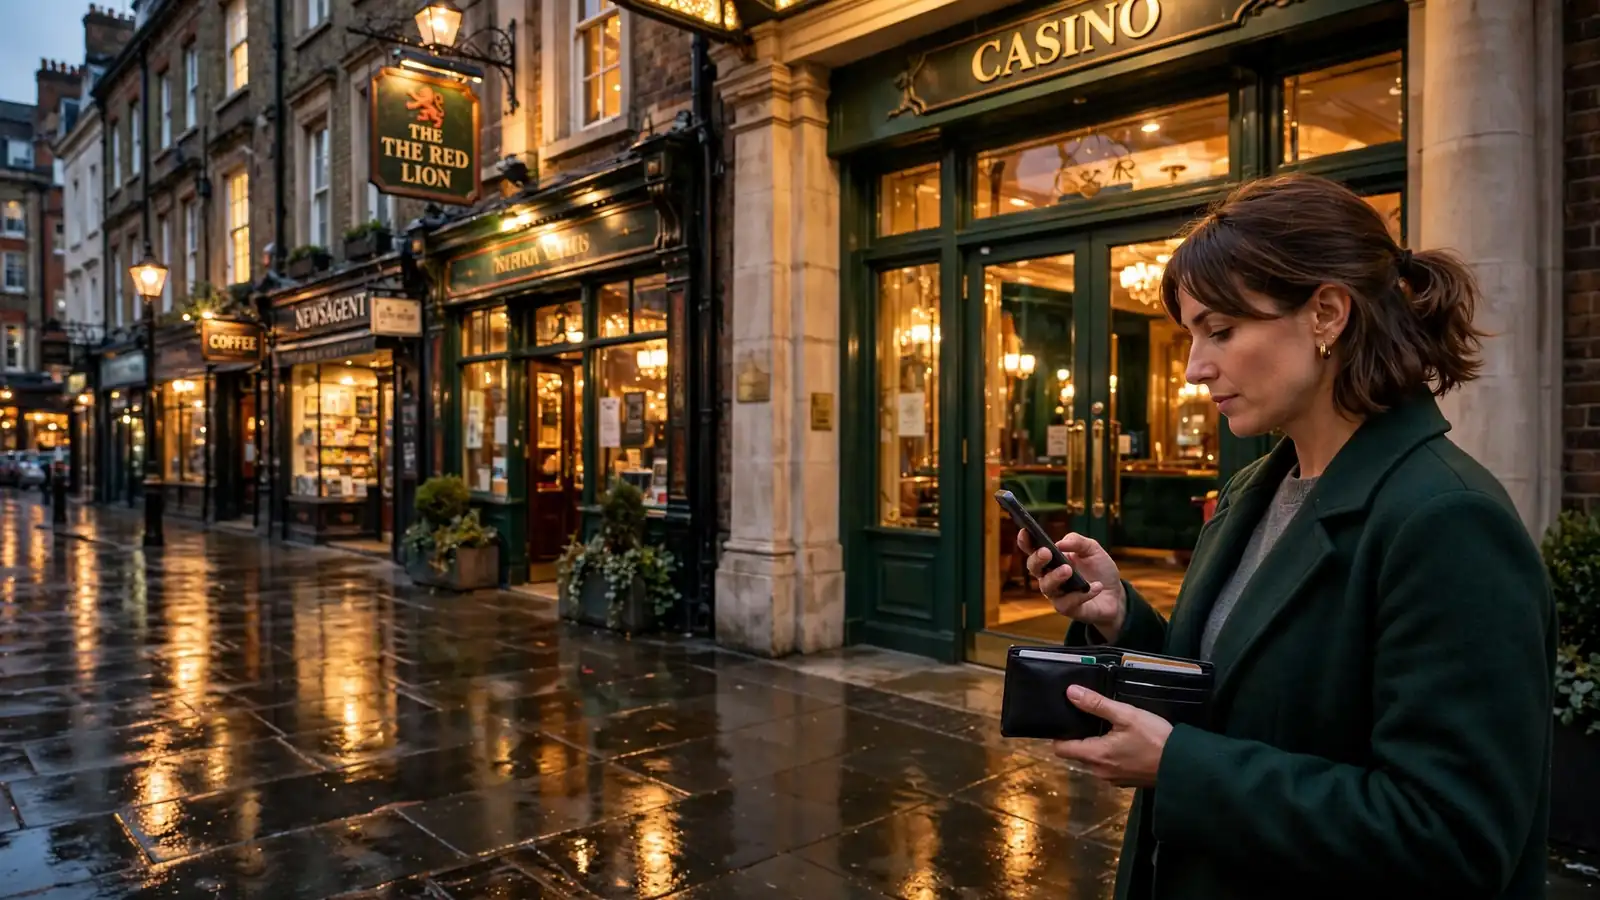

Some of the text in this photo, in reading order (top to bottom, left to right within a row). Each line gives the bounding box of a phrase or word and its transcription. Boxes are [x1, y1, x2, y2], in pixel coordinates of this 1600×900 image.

[971, 0, 1161, 83] CASINO
[408, 123, 443, 143] THE
[381, 136, 469, 169] THE RED
[401, 163, 452, 188] LION
[295, 292, 367, 331] NEWSAGENT
[208, 334, 257, 351] COFFEE
